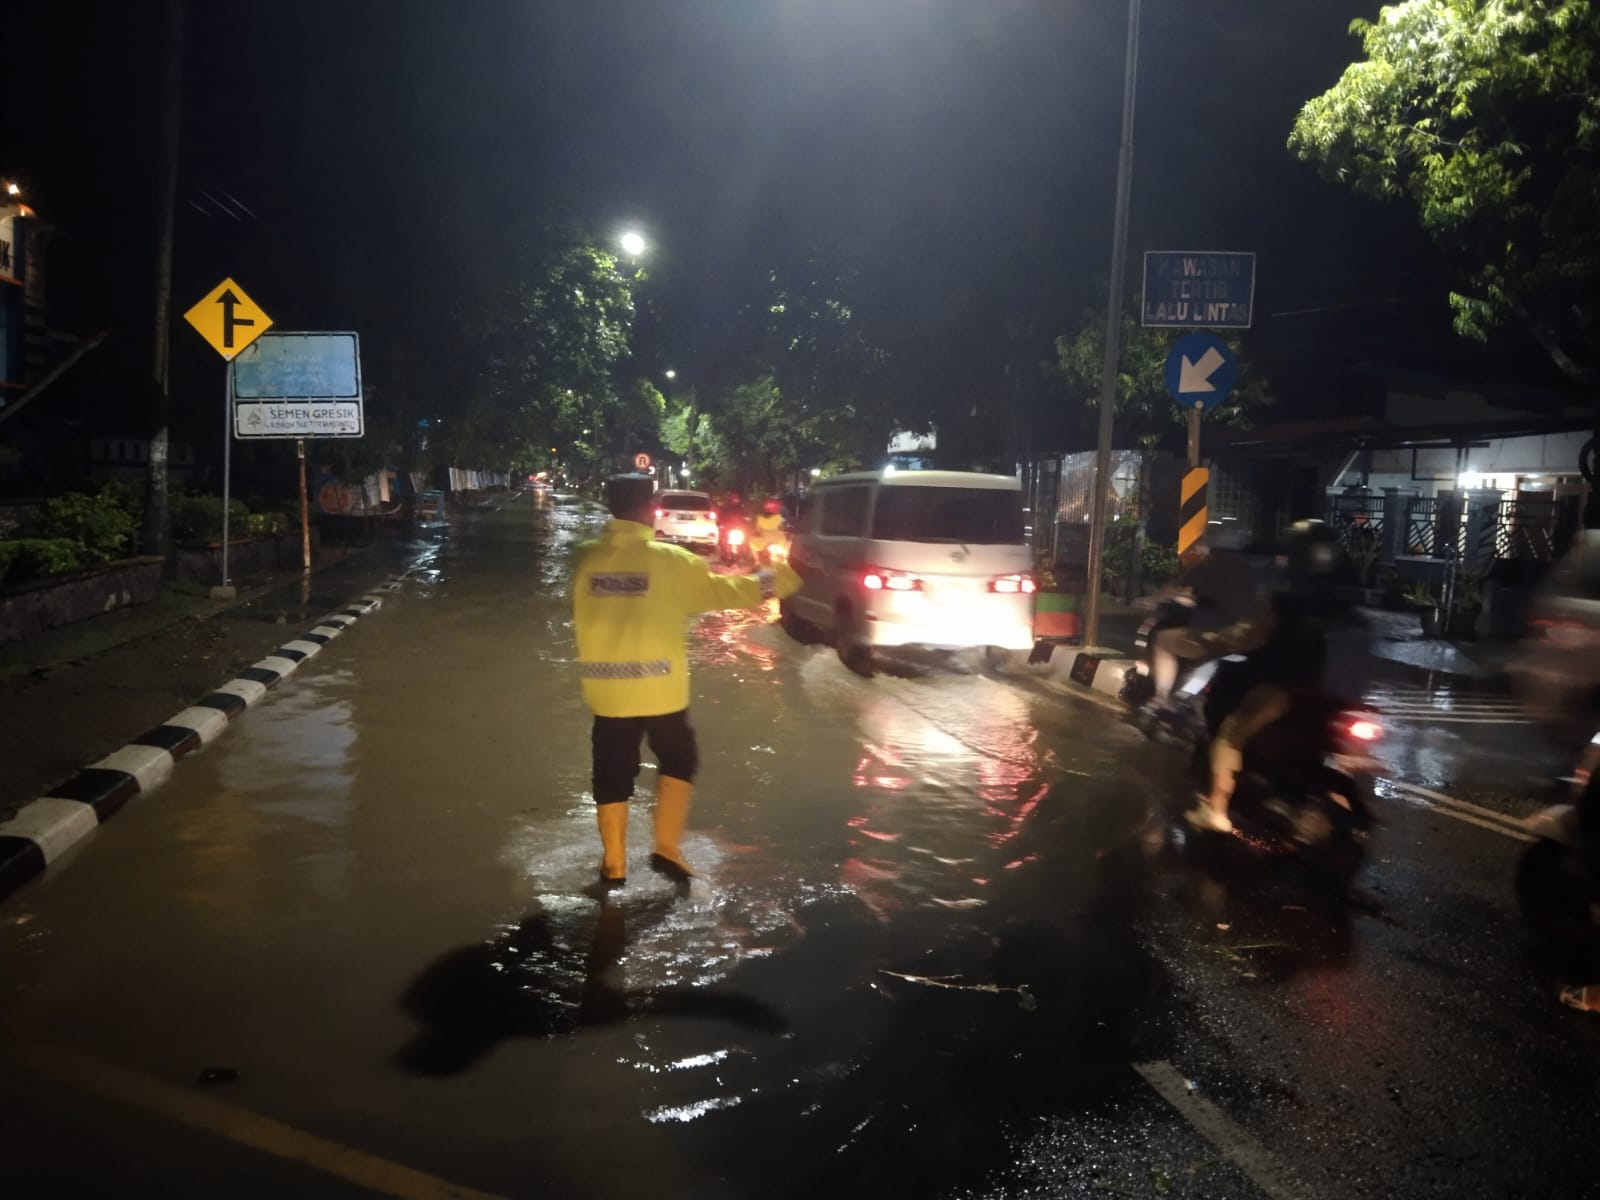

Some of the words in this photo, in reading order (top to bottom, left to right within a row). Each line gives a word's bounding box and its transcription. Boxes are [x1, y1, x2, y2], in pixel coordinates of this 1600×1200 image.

[1146, 302, 1188, 321] LALU
[1193, 303, 1247, 321] LINTAS
[270, 409, 310, 419] SEMEN
[312, 409, 354, 419] GRESIK
